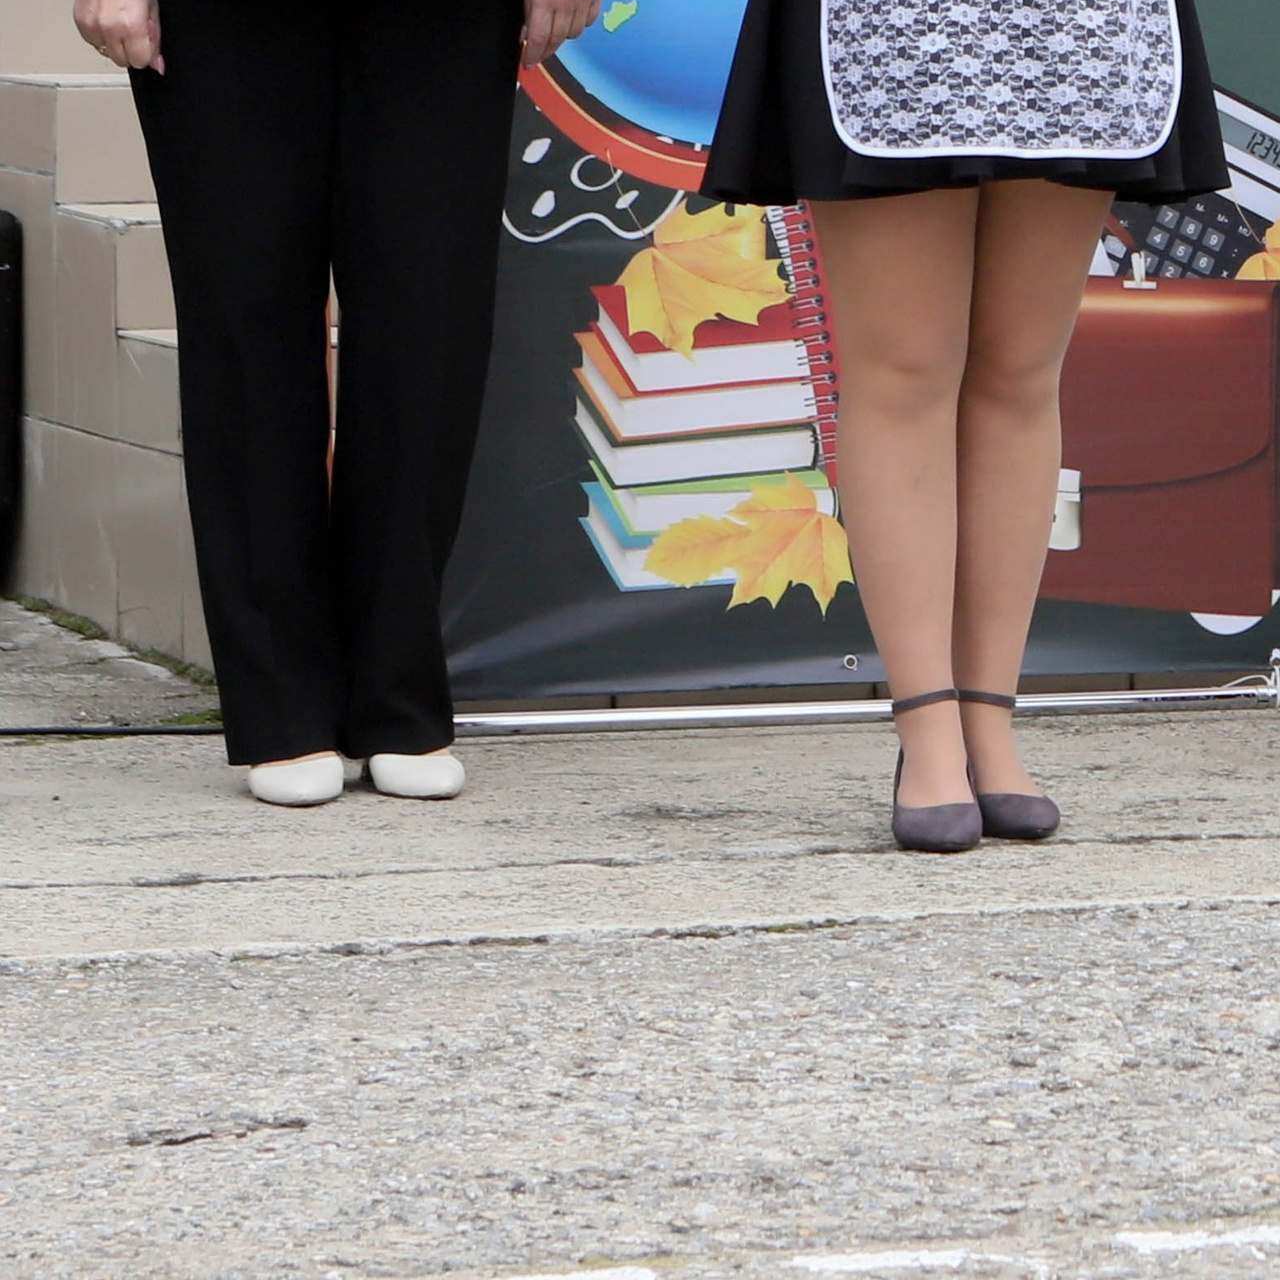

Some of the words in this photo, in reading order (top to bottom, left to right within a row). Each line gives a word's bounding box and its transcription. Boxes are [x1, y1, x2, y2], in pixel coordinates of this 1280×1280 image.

[1165, 211, 1174, 223] 7
[1186, 223, 1195, 235] 8
[1208, 234, 1218, 246] 9
[1153, 231, 1162, 243] 4
[1176, 244, 1186, 257] 5
[1199, 257, 1208, 269] 6
